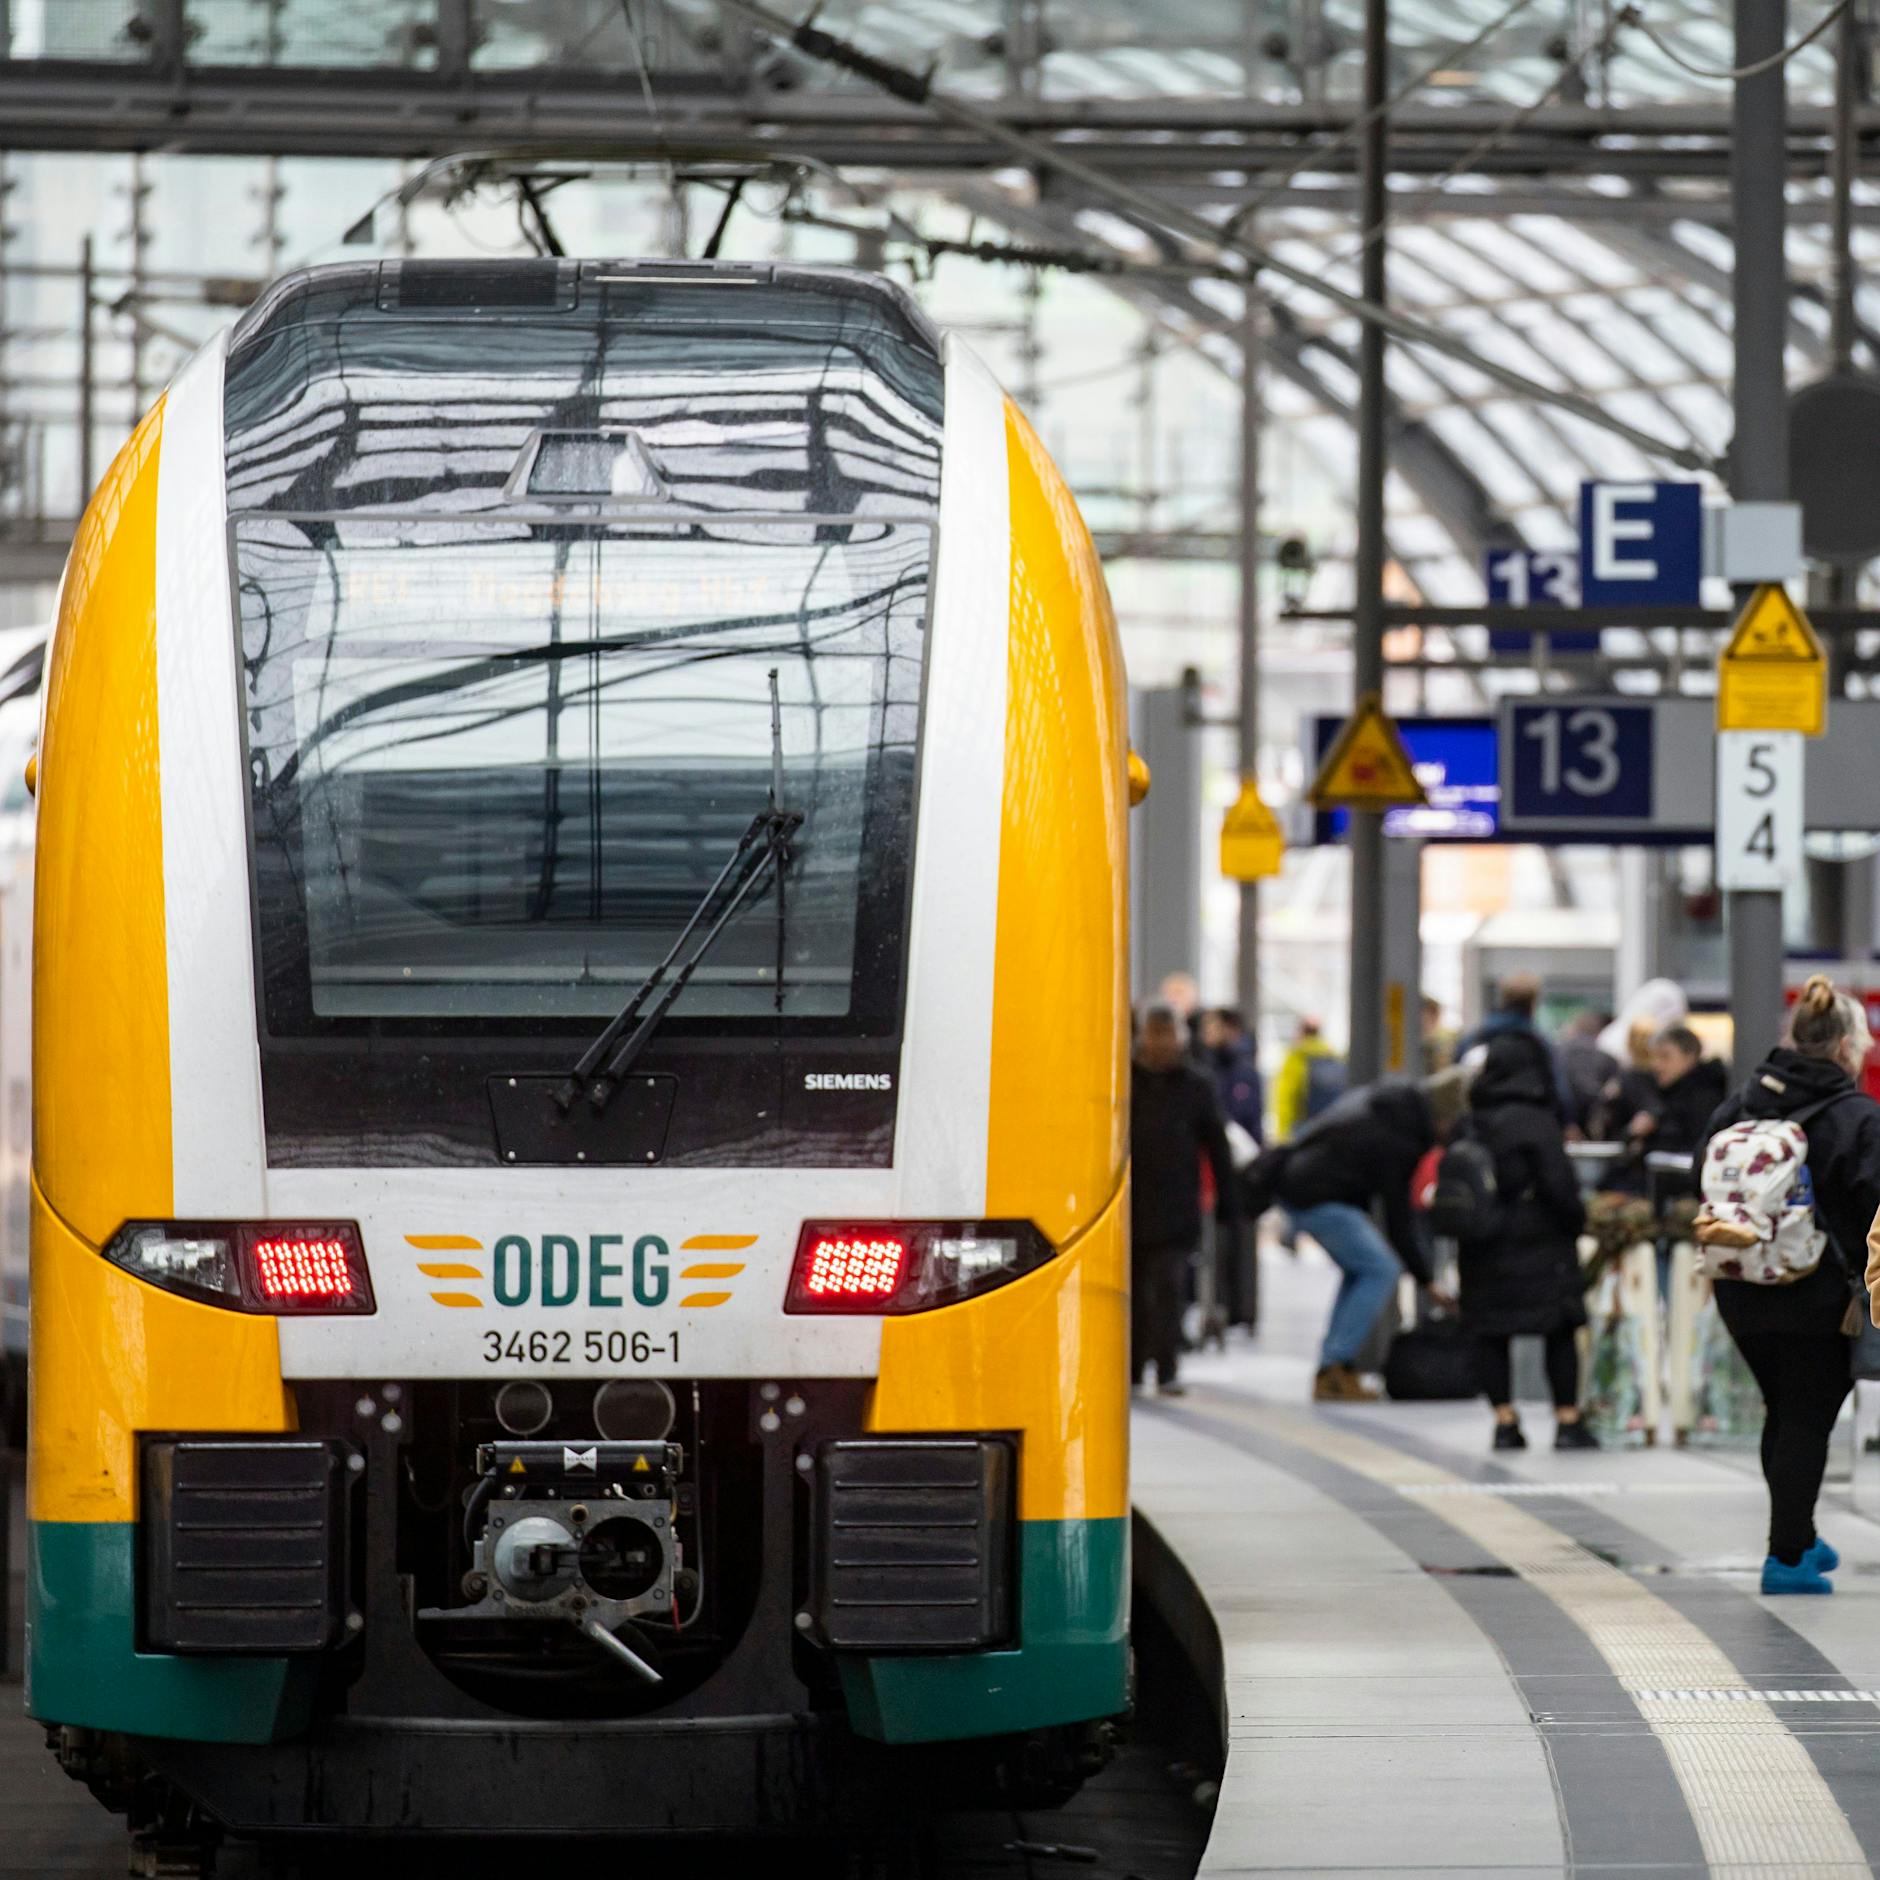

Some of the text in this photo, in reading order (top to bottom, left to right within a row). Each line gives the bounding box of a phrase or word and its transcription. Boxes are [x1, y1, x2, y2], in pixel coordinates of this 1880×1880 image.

[1592, 483, 1658, 581] E
[1524, 710, 1621, 796] 13
[1744, 744, 1776, 797] 5
[1745, 810, 1775, 861] 4
[804, 1073, 892, 1090] SIEMENS
[493, 1234, 670, 1307] ODEG
[483, 1331, 679, 1363] 3462 506-1
